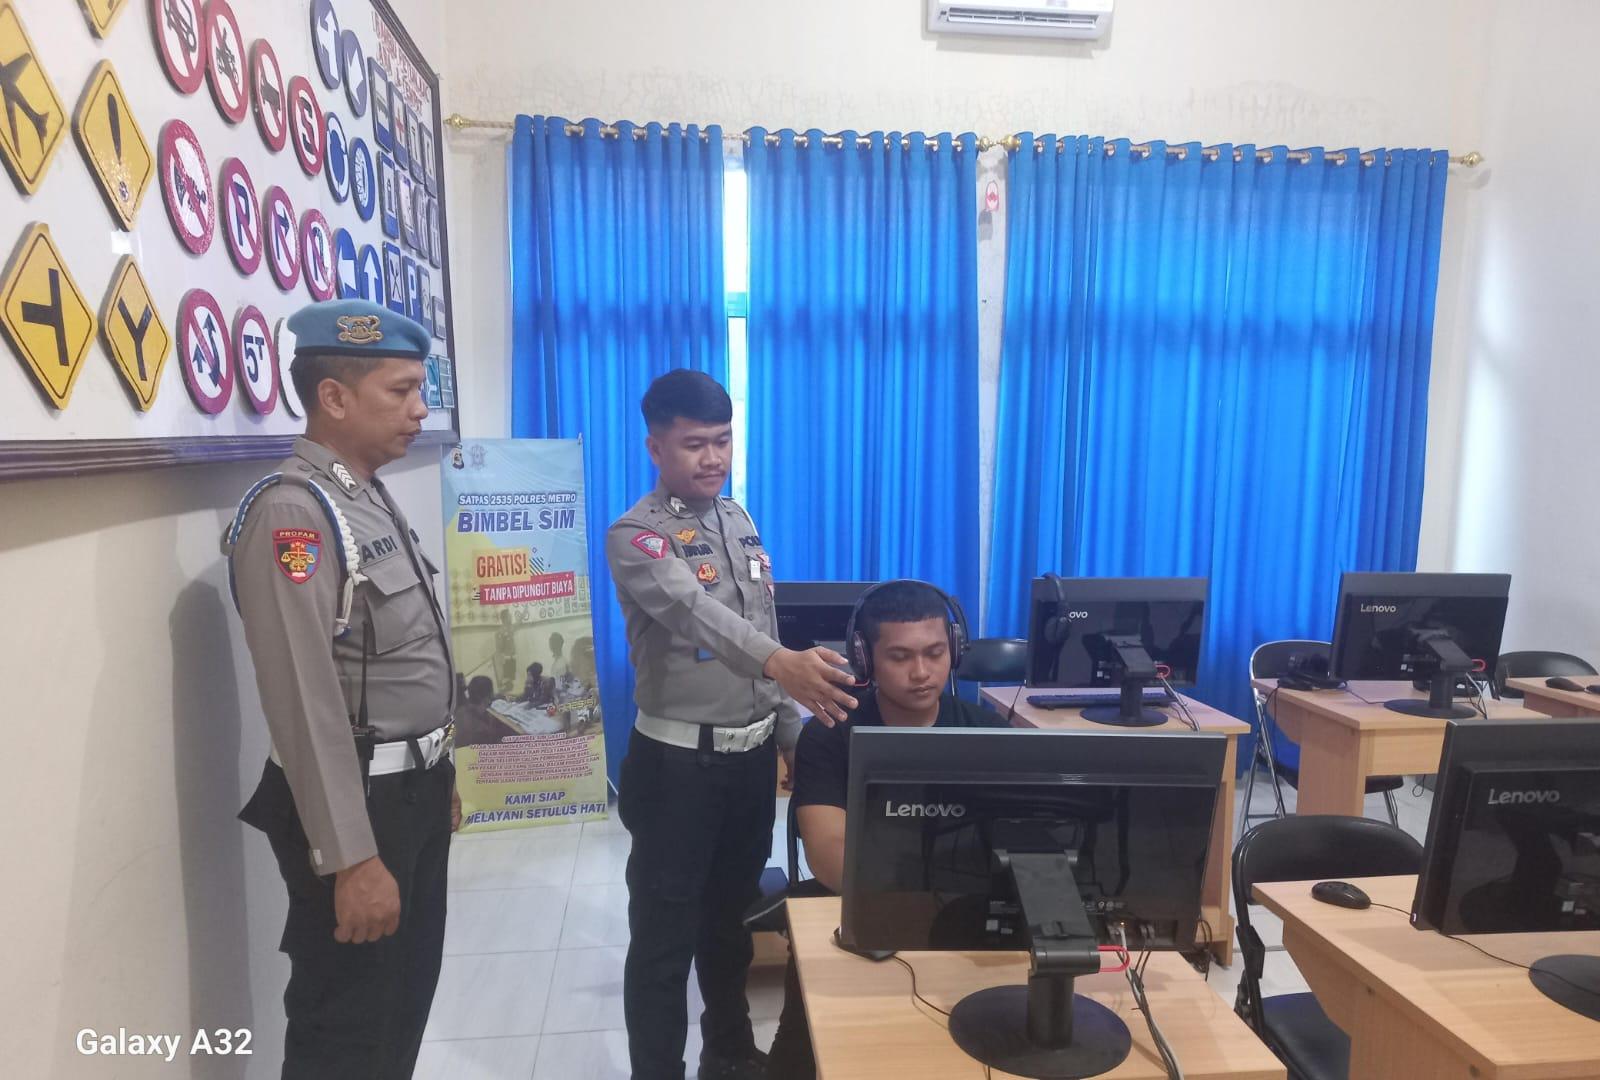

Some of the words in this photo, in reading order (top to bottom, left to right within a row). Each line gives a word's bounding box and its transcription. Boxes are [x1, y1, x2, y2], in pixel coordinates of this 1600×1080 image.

[232, 181, 251, 247] P
[407, 265, 418, 316] P
[243, 334, 265, 383] 5T
[459, 494, 489, 505] SATPAS
[490, 494, 512, 505] 2535
[514, 493, 546, 504] POLRES
[548, 493, 576, 503] METRO
[457, 511, 534, 533] BIMBEL
[538, 509, 576, 530] SIM
[361, 535, 398, 563] ARDI
[476, 554, 527, 578] GRATIS!
[484, 585, 512, 601] TANPA
[512, 582, 551, 599] DIPUNGUT
[551, 580, 573, 595] BIAYA
[1069, 611, 1089, 619] ovo
[1360, 603, 1397, 613] Lenovo
[505, 794, 536, 805] KAMI
[538, 791, 566, 801] SIAP
[1488, 788, 1560, 805] Lenovo
[464, 810, 524, 825] MELAYANI
[526, 805, 577, 819] SETULUS
[580, 802, 606, 814] HATI
[885, 801, 966, 817] Lenovo
